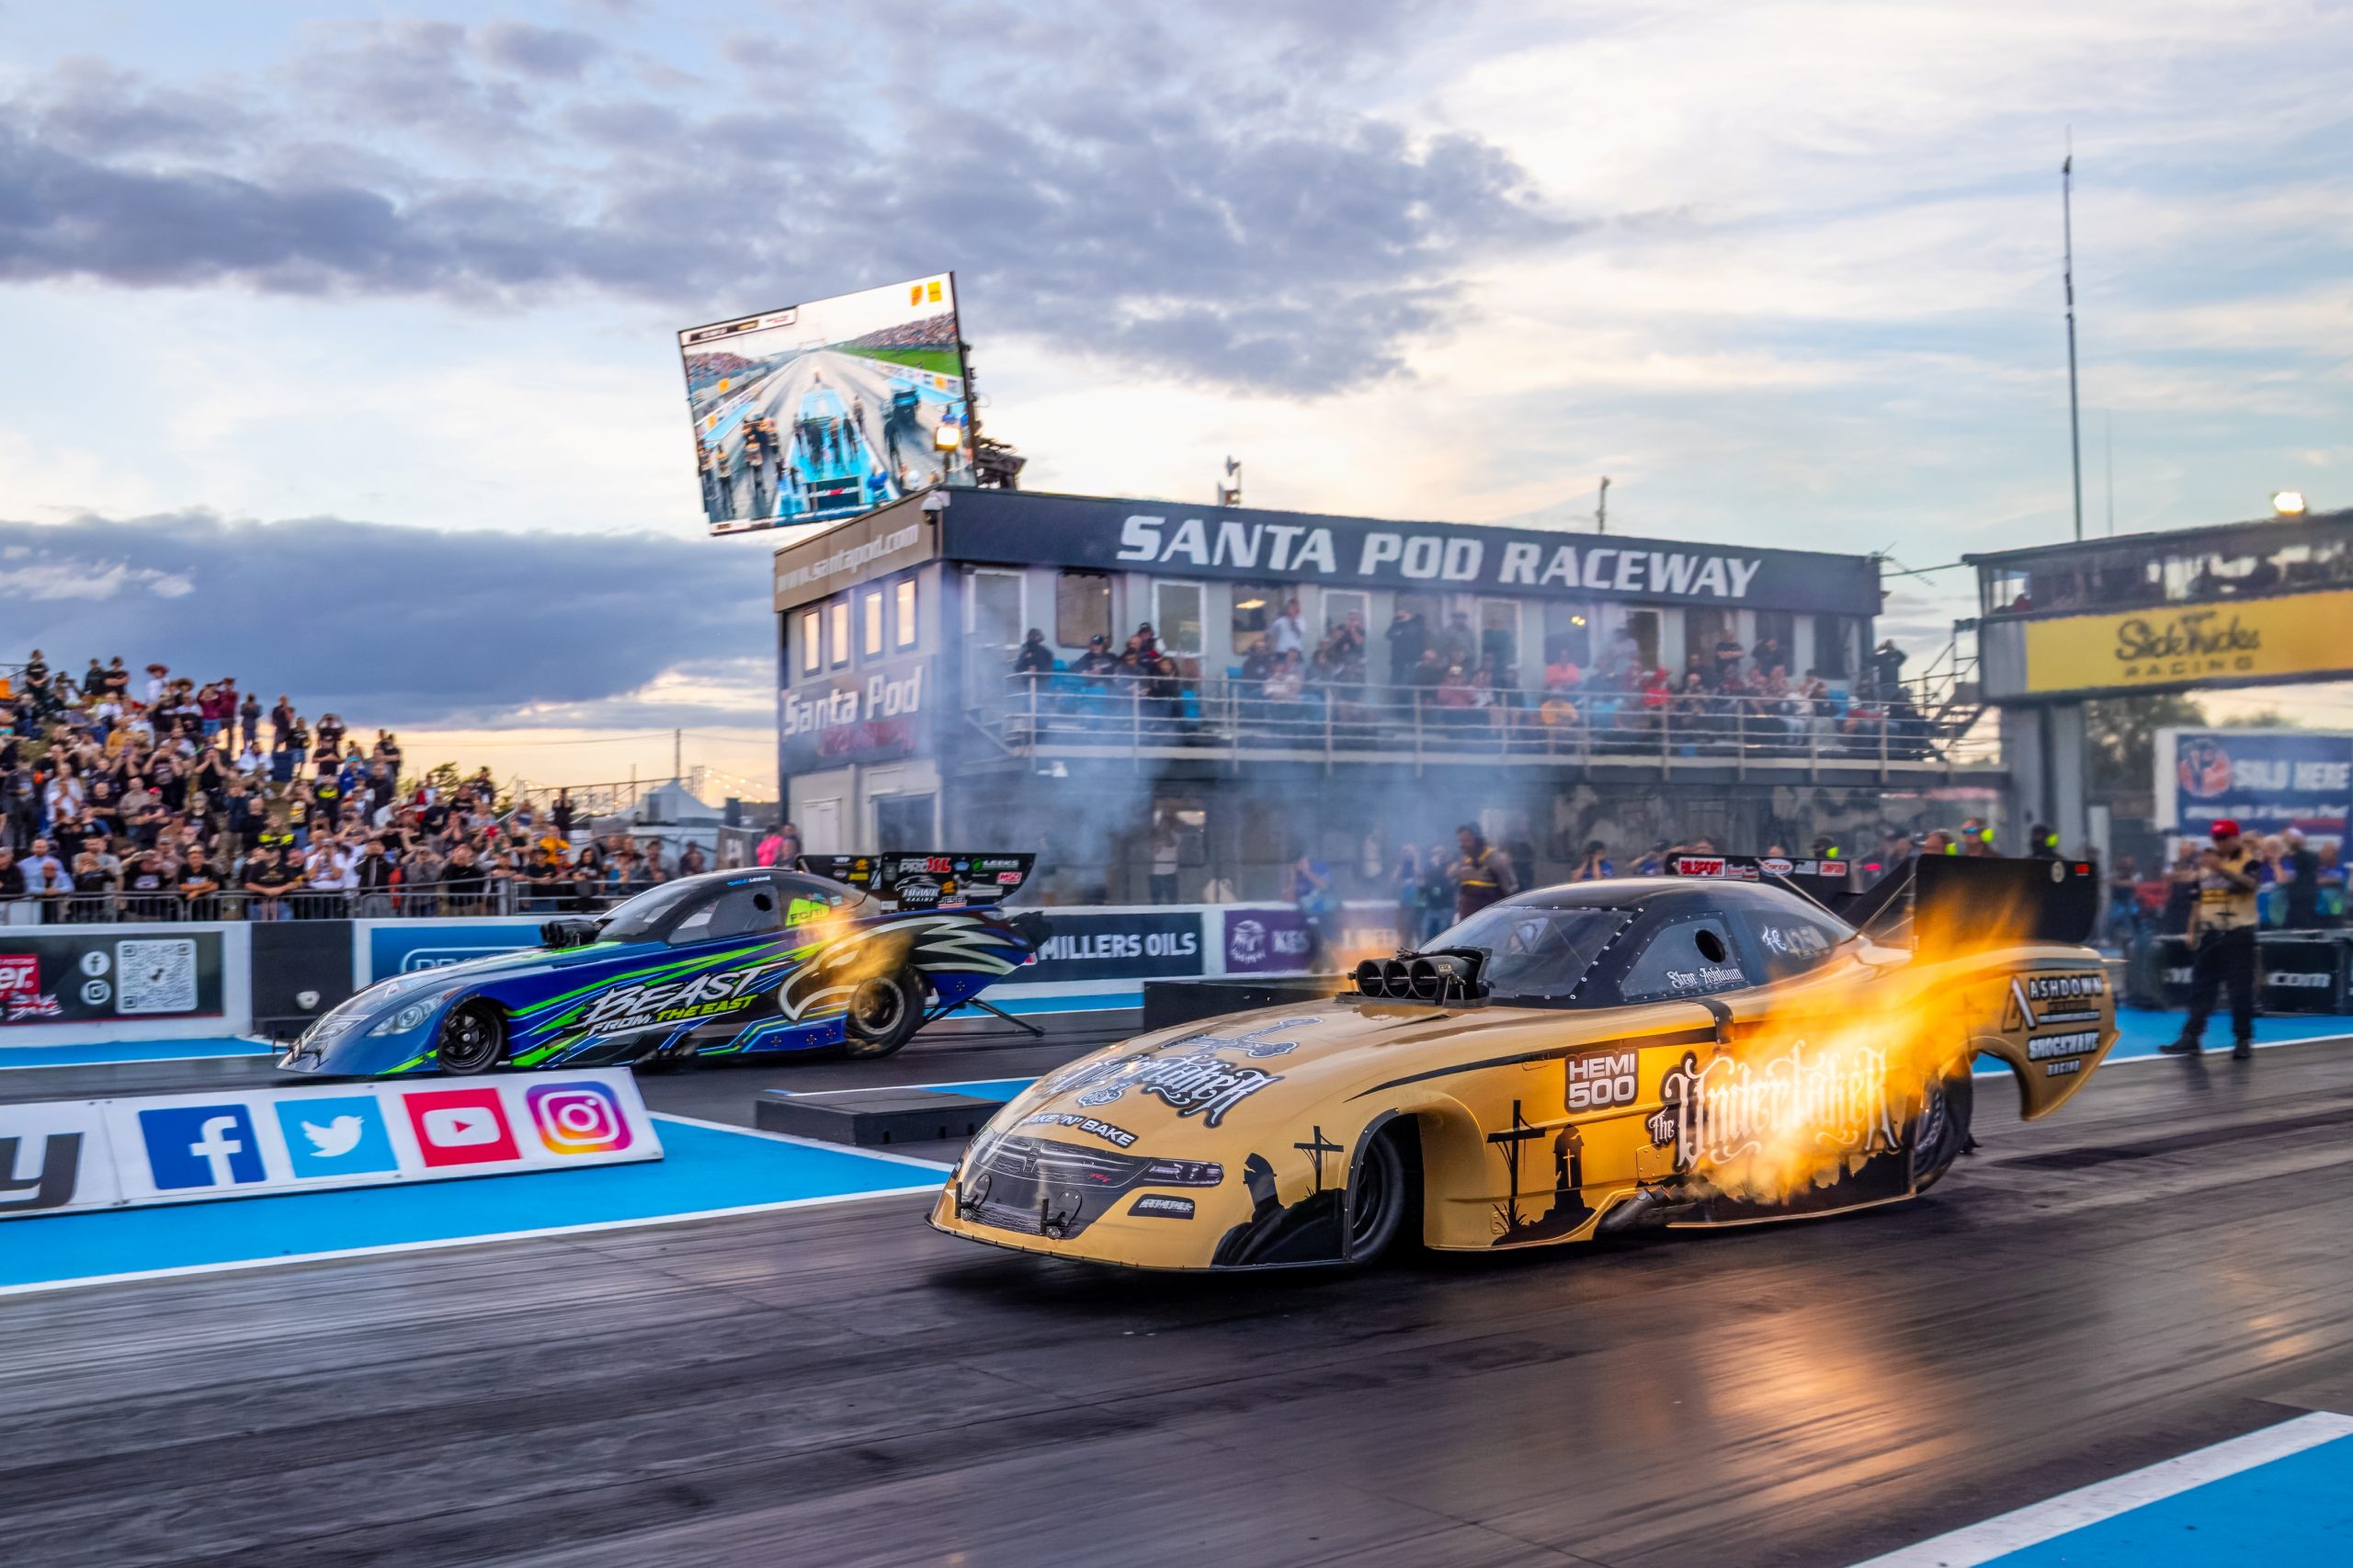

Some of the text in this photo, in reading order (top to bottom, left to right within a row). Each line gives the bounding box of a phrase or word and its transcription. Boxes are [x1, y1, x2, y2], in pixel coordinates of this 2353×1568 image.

[1117, 515, 1763, 598] SANTA POD RACEWAY
[783, 665, 924, 736] Santa Pod
[1040, 932, 1197, 960] MILLERS OILS
[579, 966, 772, 1028] BEAST
[2029, 976, 2103, 999] ASHDOWN
[655, 1006, 700, 1023] THE
[700, 994, 758, 1014] EAST
[1568, 1053, 1635, 1082] HEMI
[1568, 1075, 1635, 1108] 500
[1081, 1119, 1135, 1146] BAKE
[1648, 1106, 1675, 1144] The
